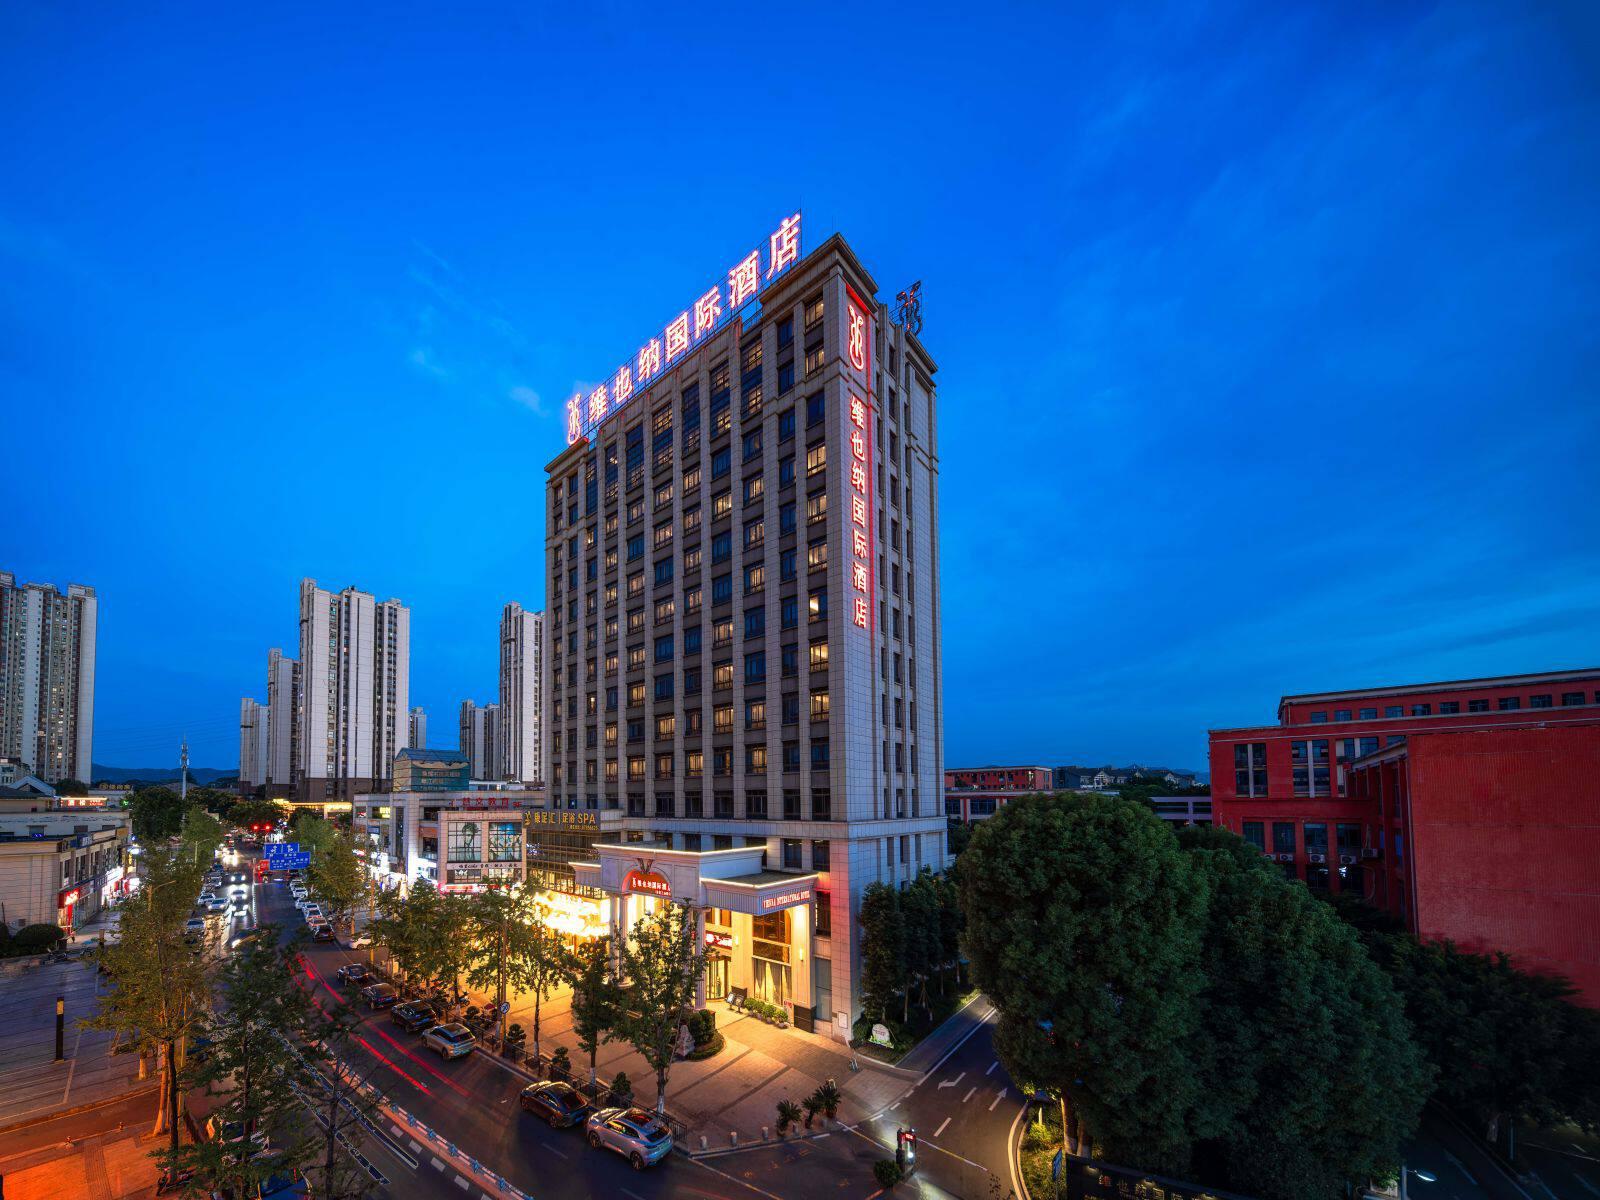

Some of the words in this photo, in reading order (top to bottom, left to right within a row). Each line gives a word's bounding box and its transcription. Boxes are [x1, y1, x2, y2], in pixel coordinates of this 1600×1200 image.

[587, 213, 801, 423] 维也纳国际酒店
[851, 396, 867, 628] 维也纳国际酒店
[577, 812, 595, 824] SPA
